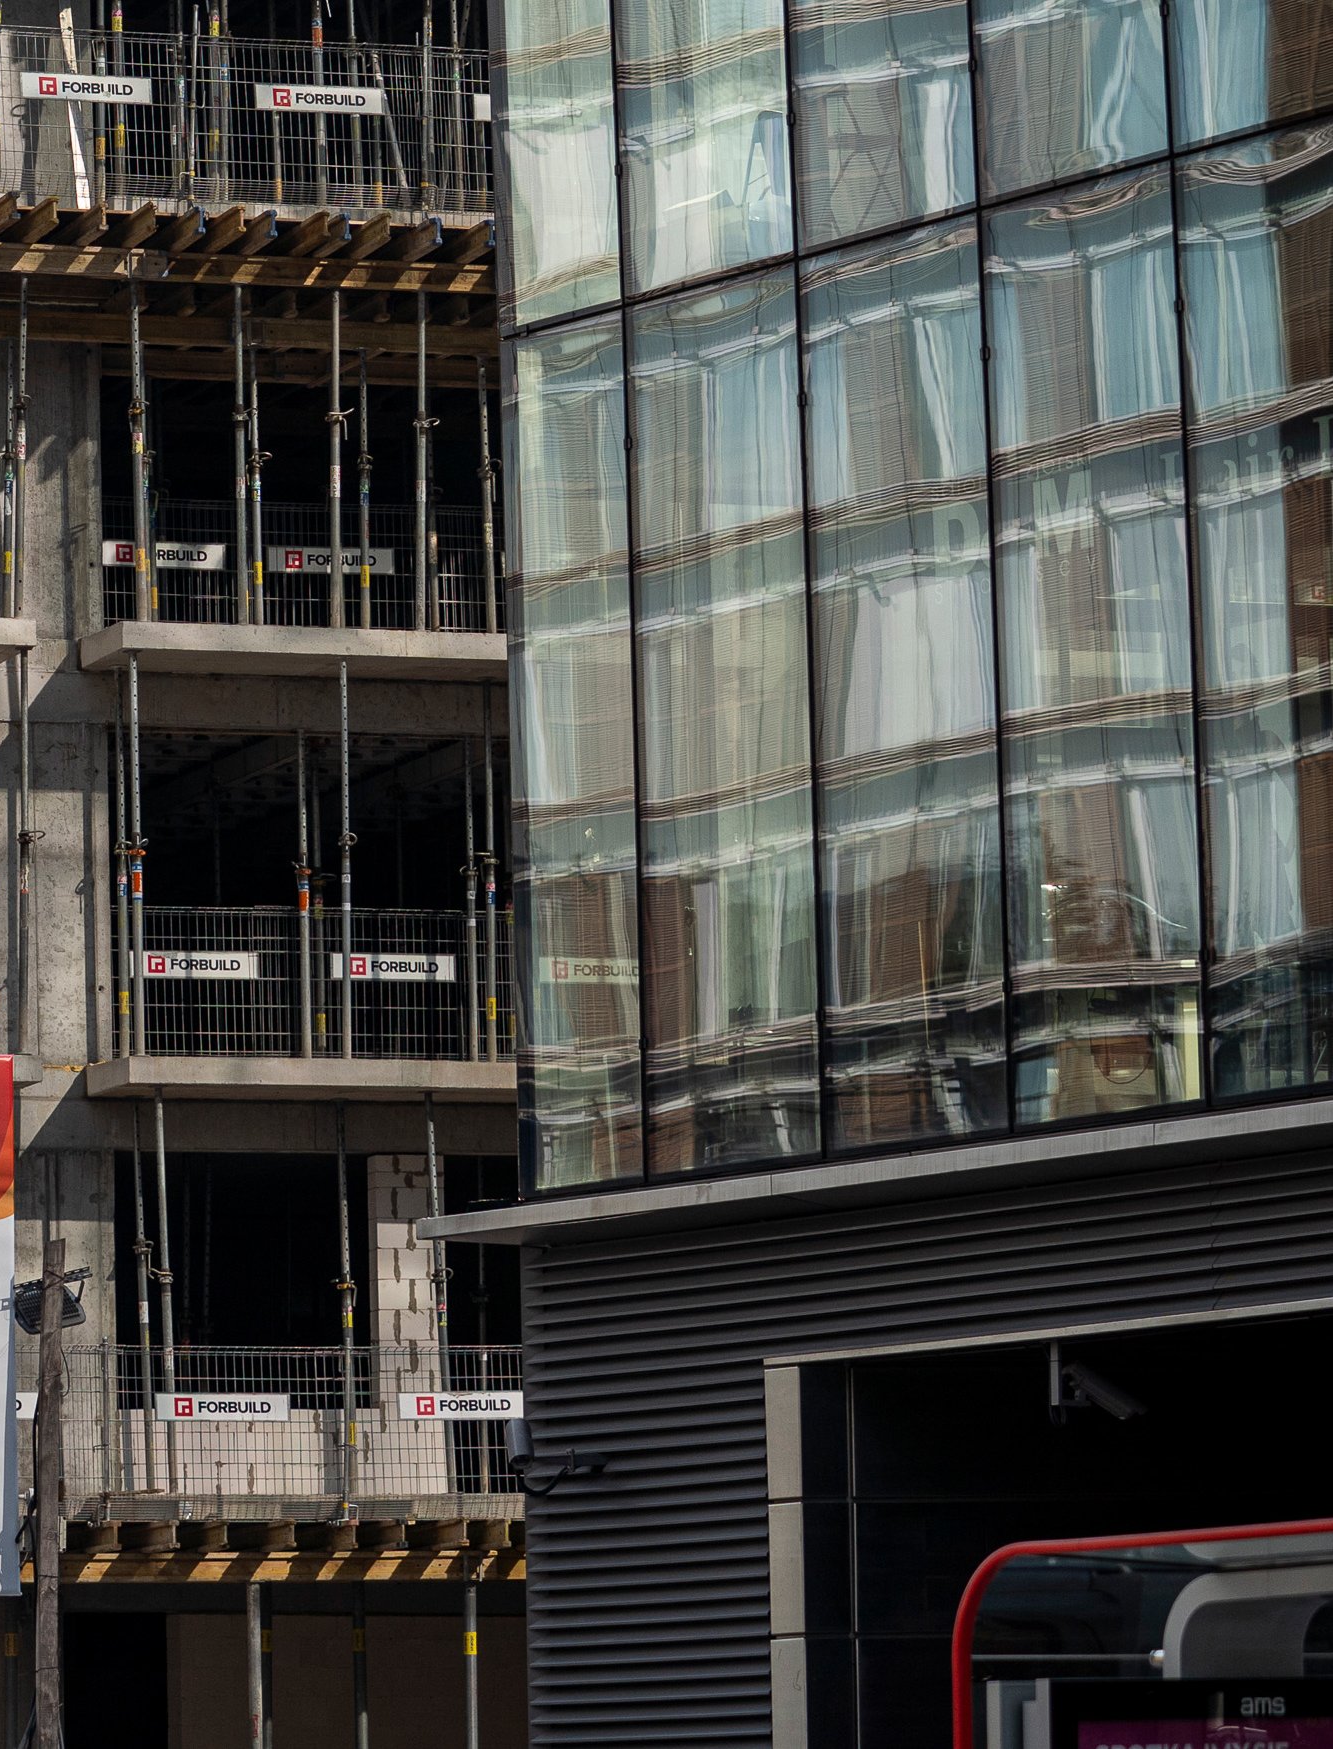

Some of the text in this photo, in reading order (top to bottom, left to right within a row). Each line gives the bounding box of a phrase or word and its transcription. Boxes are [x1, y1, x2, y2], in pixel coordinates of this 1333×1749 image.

[61, 81, 134, 96] FORBUILD
[295, 92, 366, 107] FORBUILD
[156, 547, 208, 563] RBUILD
[170, 957, 241, 972] FORBUILD
[370, 960, 440, 975] FORBUILD
[197, 1400, 272, 1414] FORBUILD
[439, 1398, 512, 1413] FORBUILD
[1241, 1697, 1285, 1714] ams
